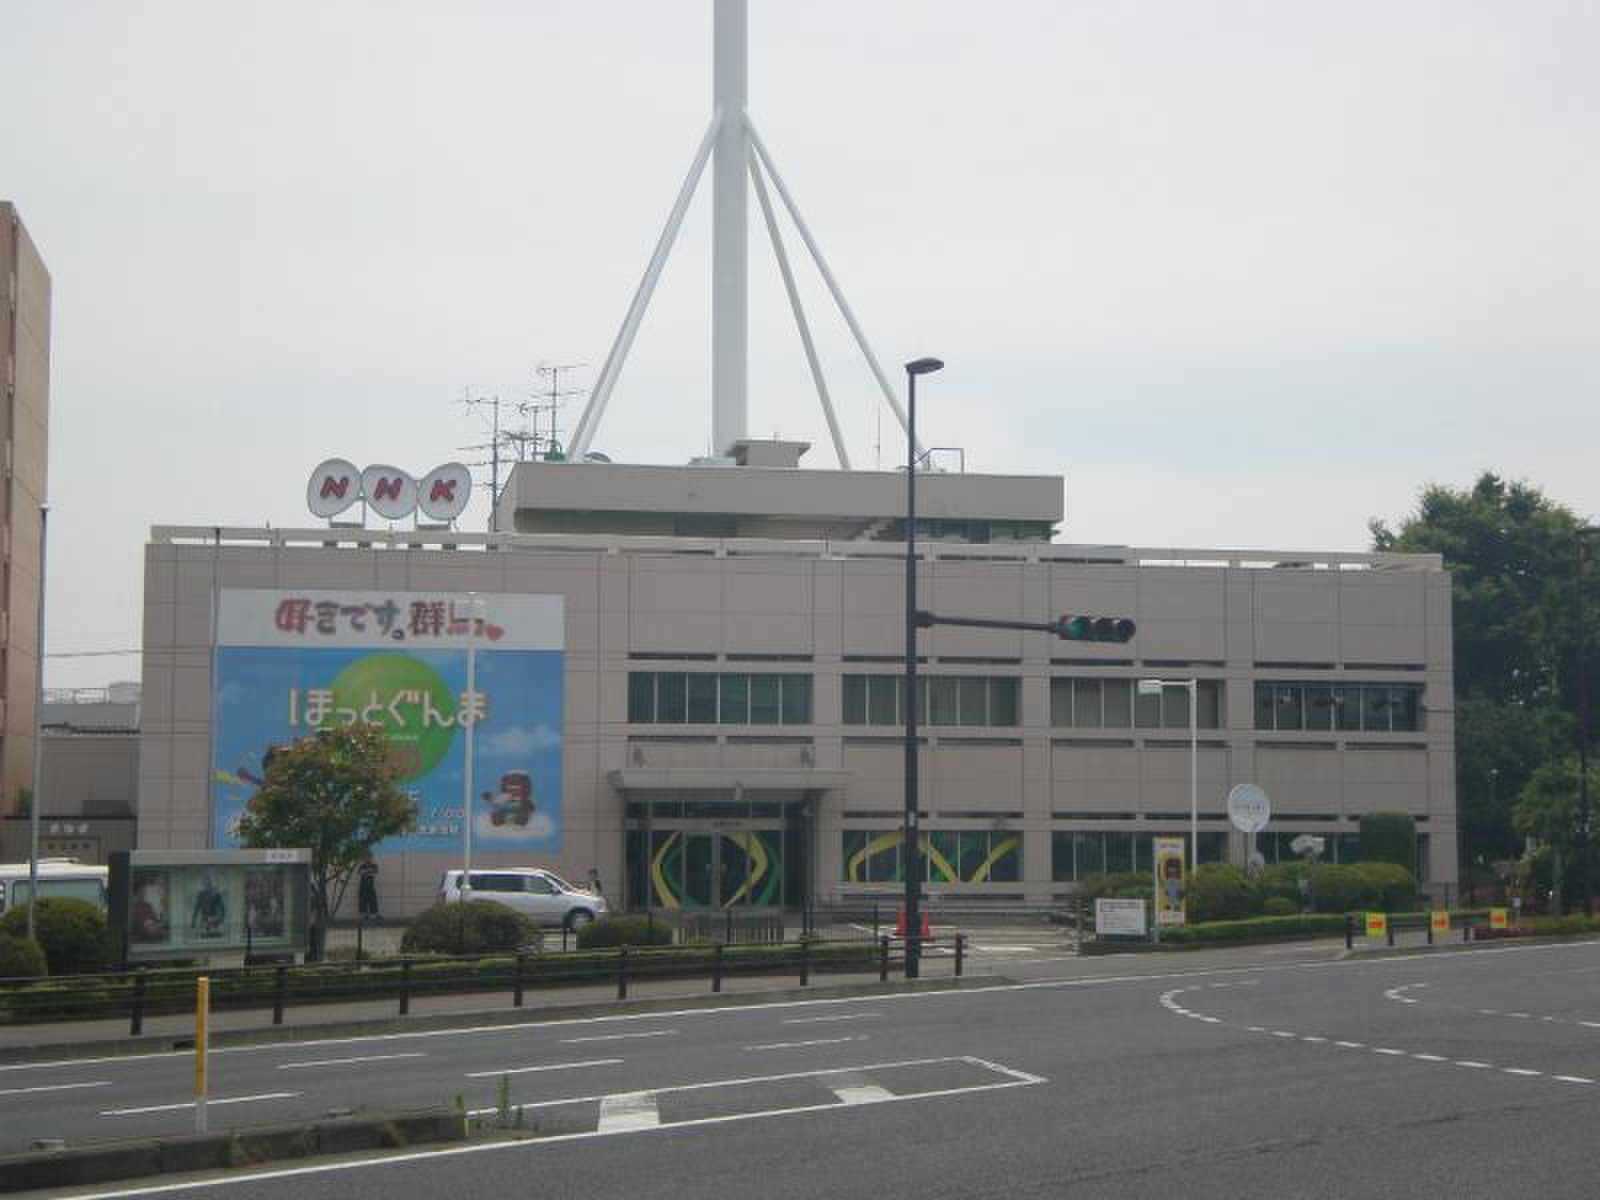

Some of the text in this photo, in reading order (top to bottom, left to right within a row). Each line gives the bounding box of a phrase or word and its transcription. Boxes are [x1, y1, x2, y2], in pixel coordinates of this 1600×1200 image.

[319, 475, 457, 502] NHK
[289, 688, 488, 728] ほっとぐんま
